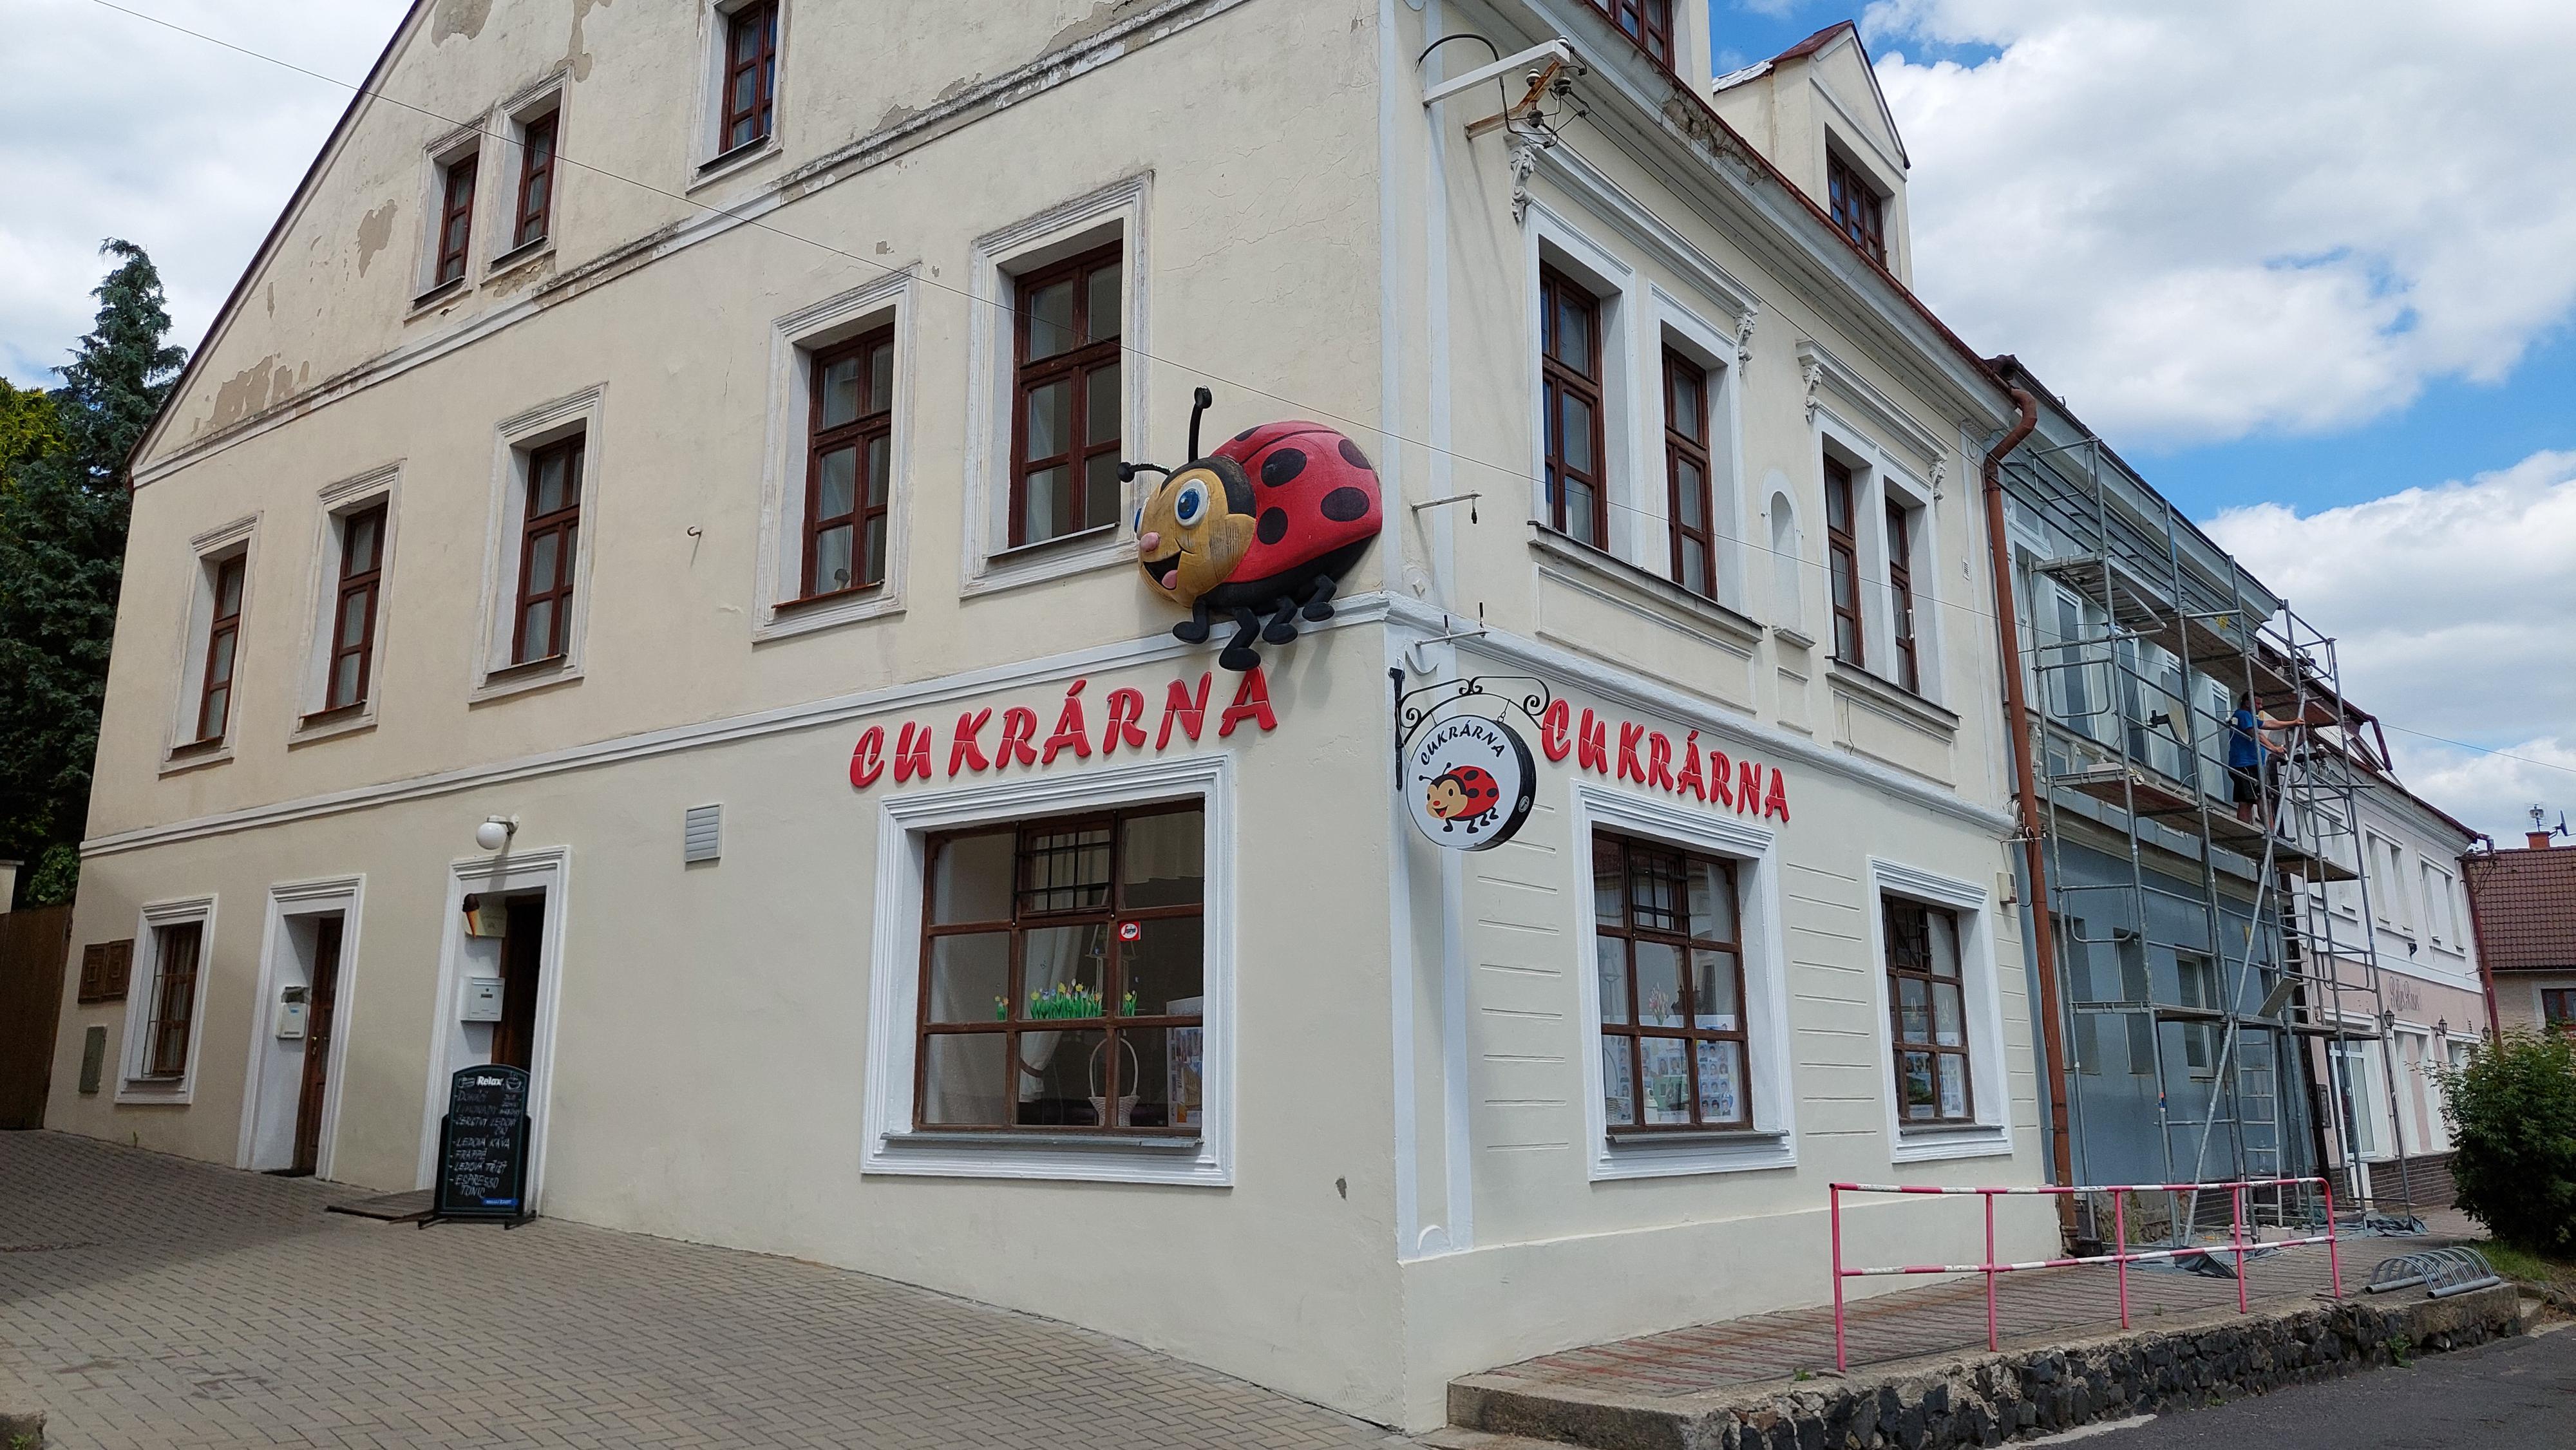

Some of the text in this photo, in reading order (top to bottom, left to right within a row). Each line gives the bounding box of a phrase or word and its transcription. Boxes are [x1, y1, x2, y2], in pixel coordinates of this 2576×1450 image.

[849, 666, 1278, 789] CUKRÁRNA
[1421, 719, 1505, 766] CUKRÁRNA
[1541, 697, 1790, 823] CUKRÁRNA
[476, 1075, 503, 1086] Relax
[455, 1173, 499, 1189] ESPRESSO
